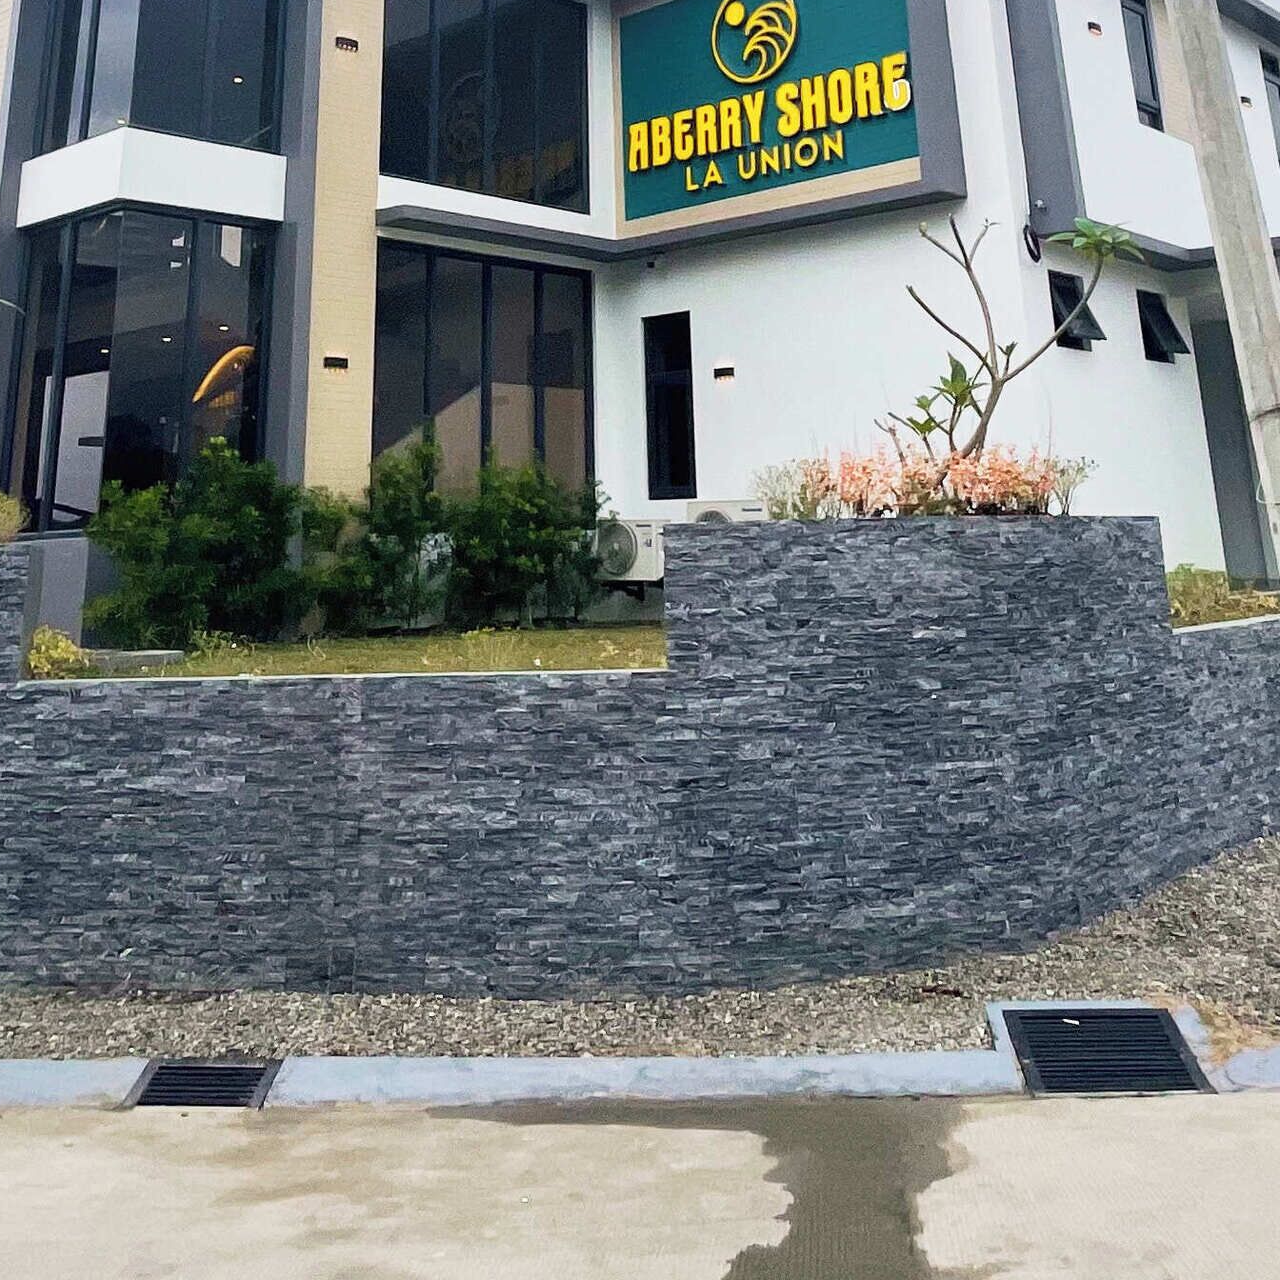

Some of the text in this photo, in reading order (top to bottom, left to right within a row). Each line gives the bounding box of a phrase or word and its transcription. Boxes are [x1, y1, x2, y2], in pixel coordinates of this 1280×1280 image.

[628, 52, 911, 171] ABERRY SHORE
[685, 130, 844, 191] LA UNION
